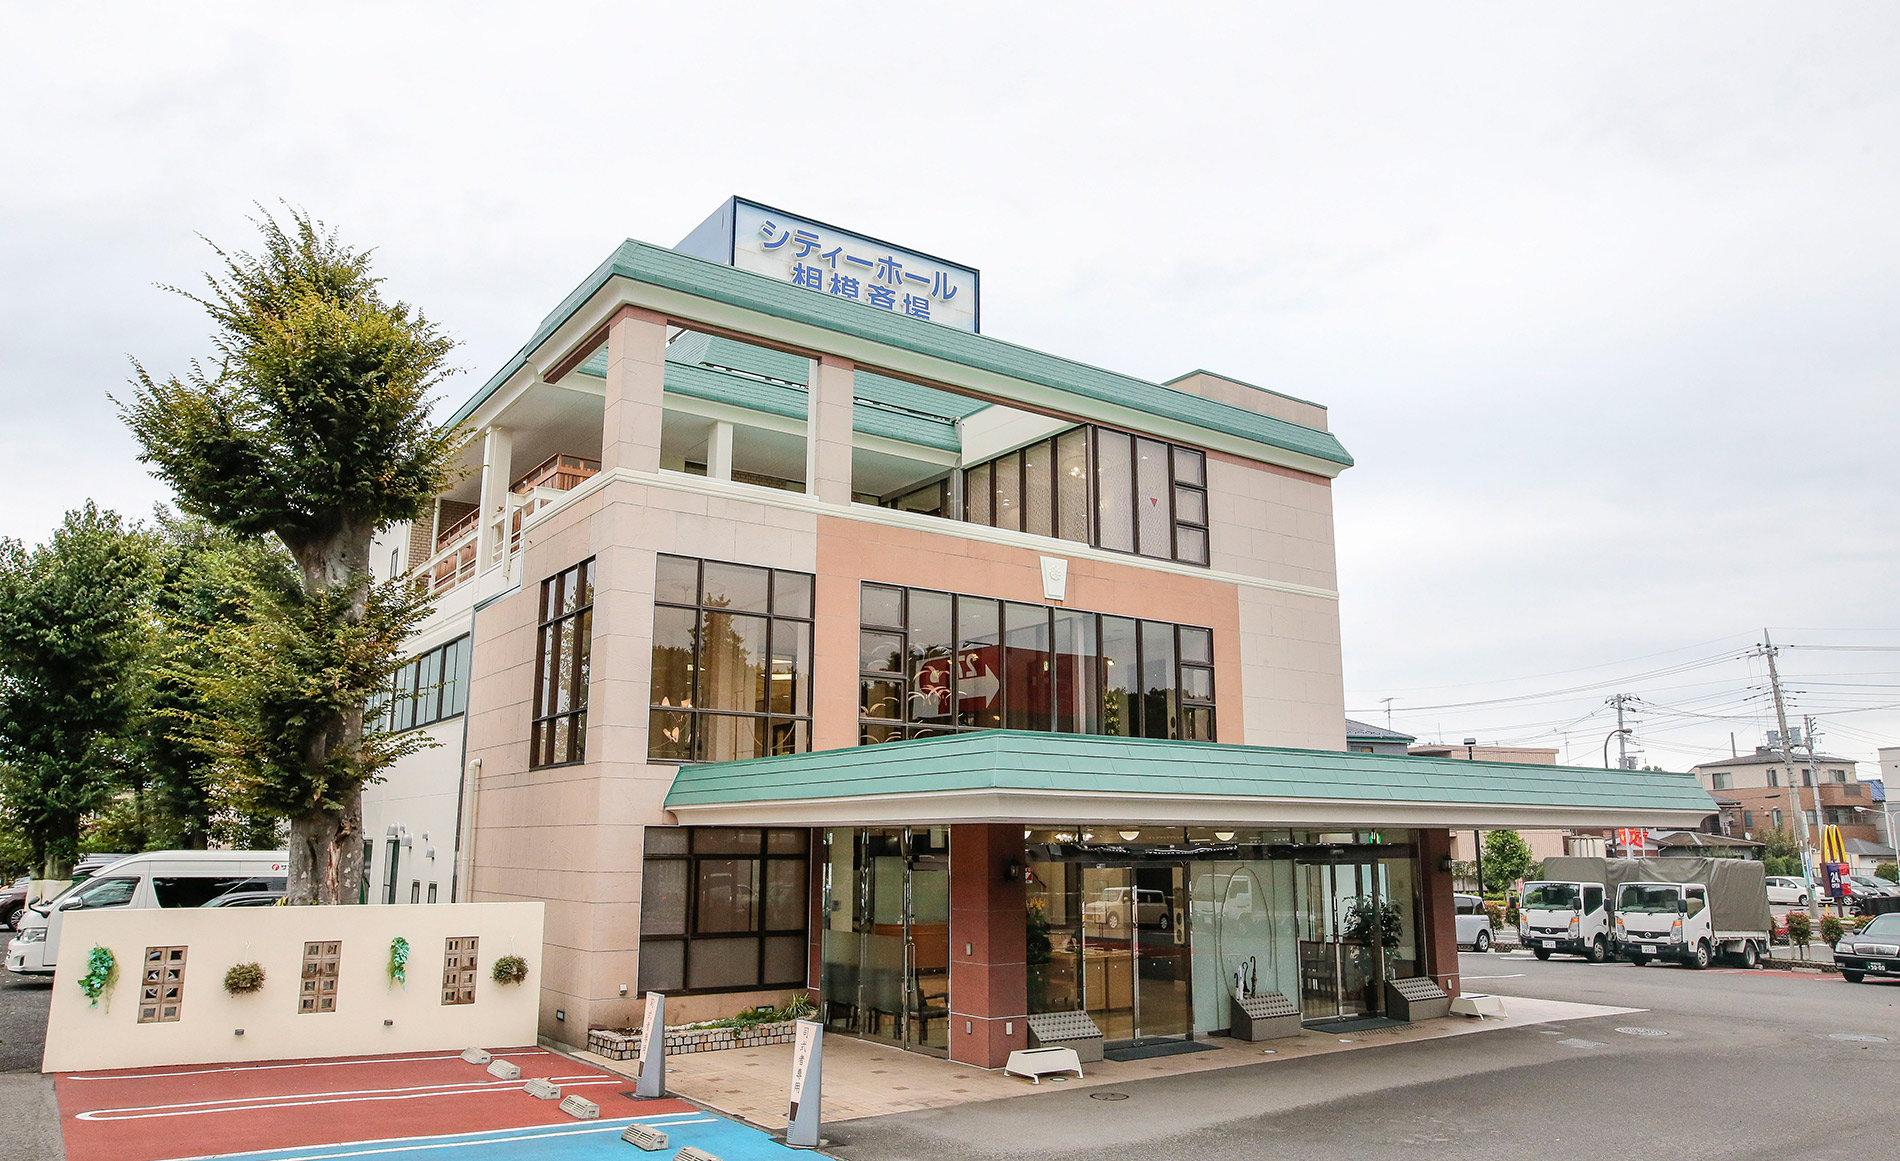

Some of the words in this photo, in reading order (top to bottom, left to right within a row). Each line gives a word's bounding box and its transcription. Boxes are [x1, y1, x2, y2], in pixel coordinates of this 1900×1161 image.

[760, 218, 958, 301] シティーホール
